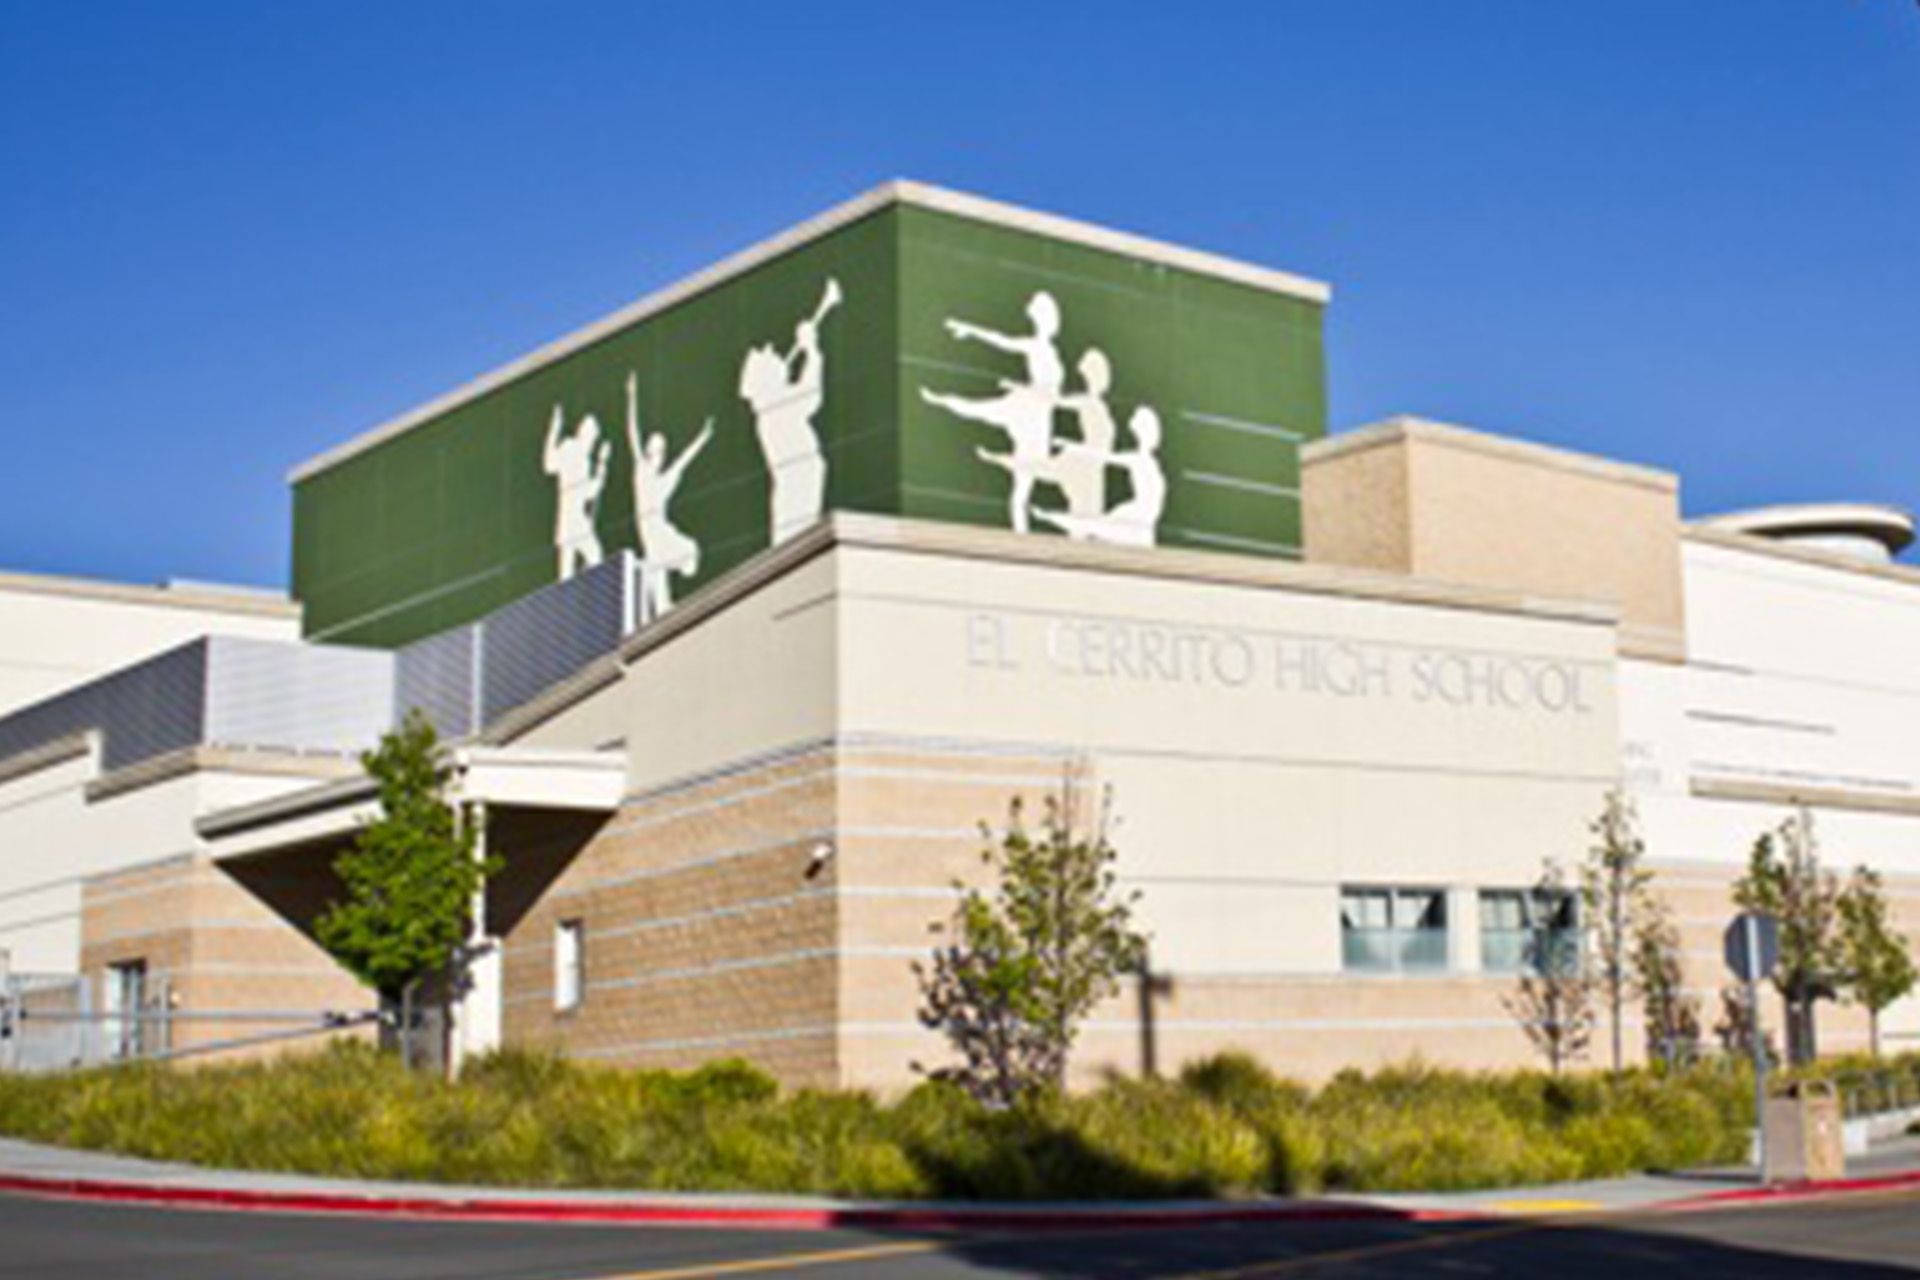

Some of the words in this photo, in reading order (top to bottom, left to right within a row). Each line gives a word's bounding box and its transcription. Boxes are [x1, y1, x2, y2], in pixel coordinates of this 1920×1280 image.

[966, 614, 1018, 668] EL
[1047, 620, 1255, 687] CERRITO
[1275, 641, 1392, 697] HIGH
[1411, 651, 1592, 713] SCHOOL
